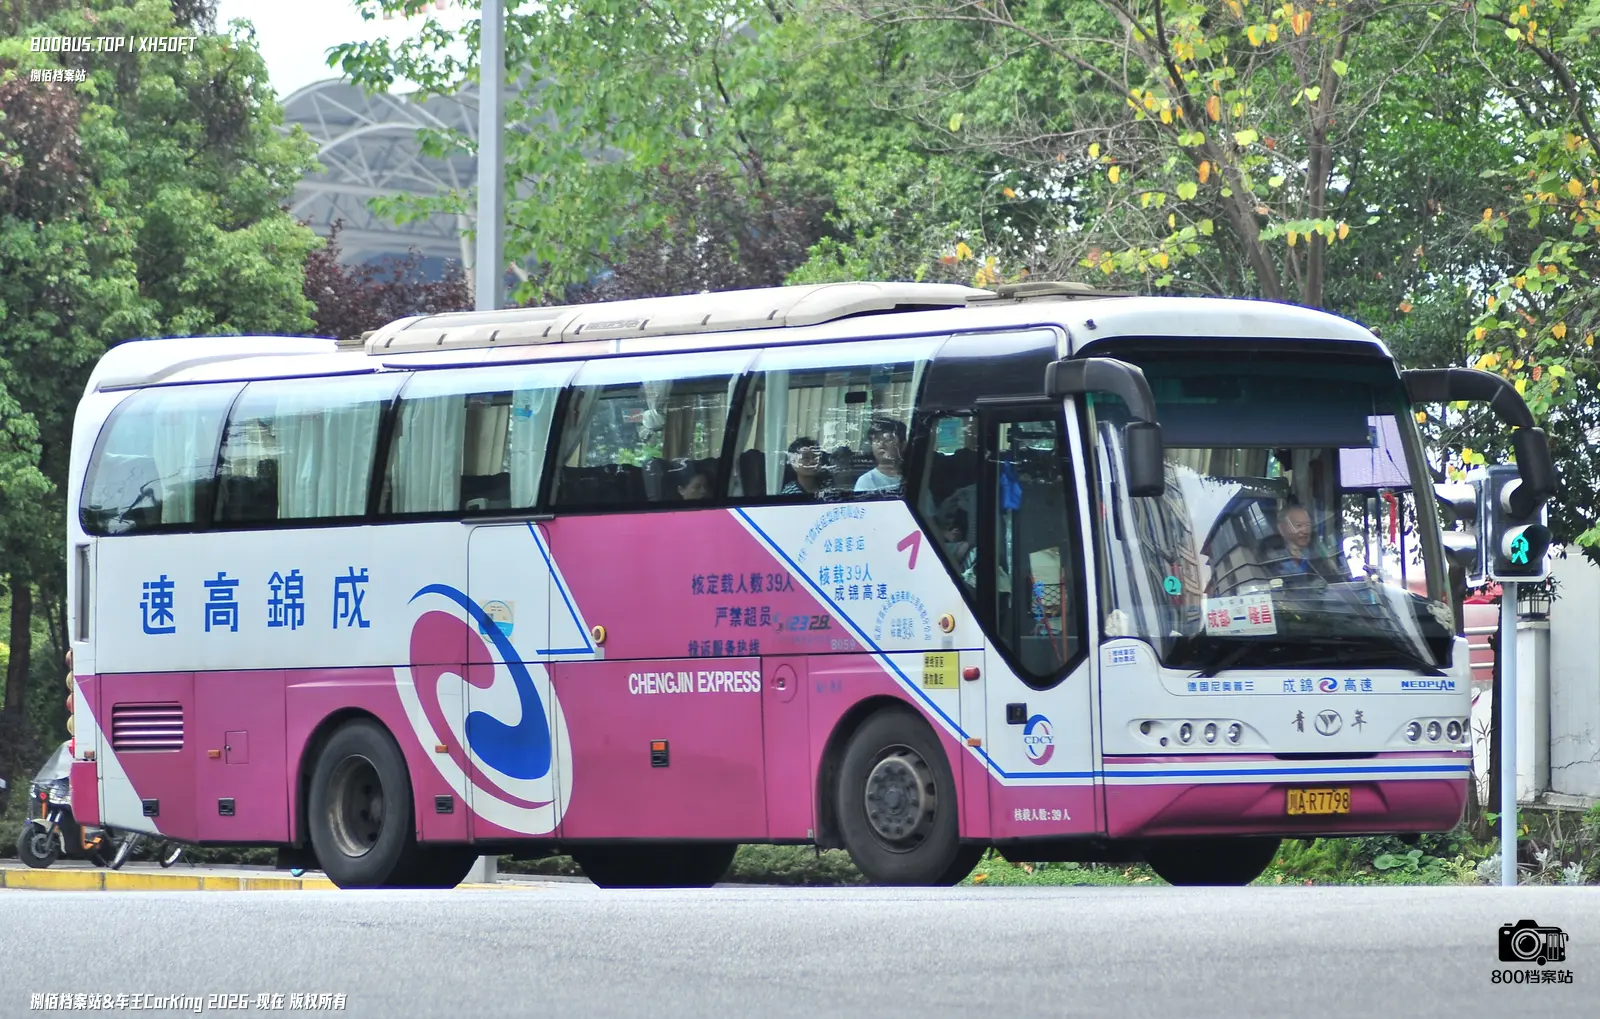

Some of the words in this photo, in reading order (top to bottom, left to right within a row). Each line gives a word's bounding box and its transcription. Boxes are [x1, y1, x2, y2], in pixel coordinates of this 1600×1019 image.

[691, 572, 795, 595] 核定载人数39人
[834, 583, 888, 601] 成锦高速
[714, 606, 772, 628] 严禁超员
[628, 672, 694, 695] CHENGJIN
[697, 671, 762, 693] EXPRESS
[1187, 681, 1255, 692] 德国尼奥普兰
[1401, 680, 1455, 691] NEOPLAN
[1024, 735, 1055, 744] CDCY
